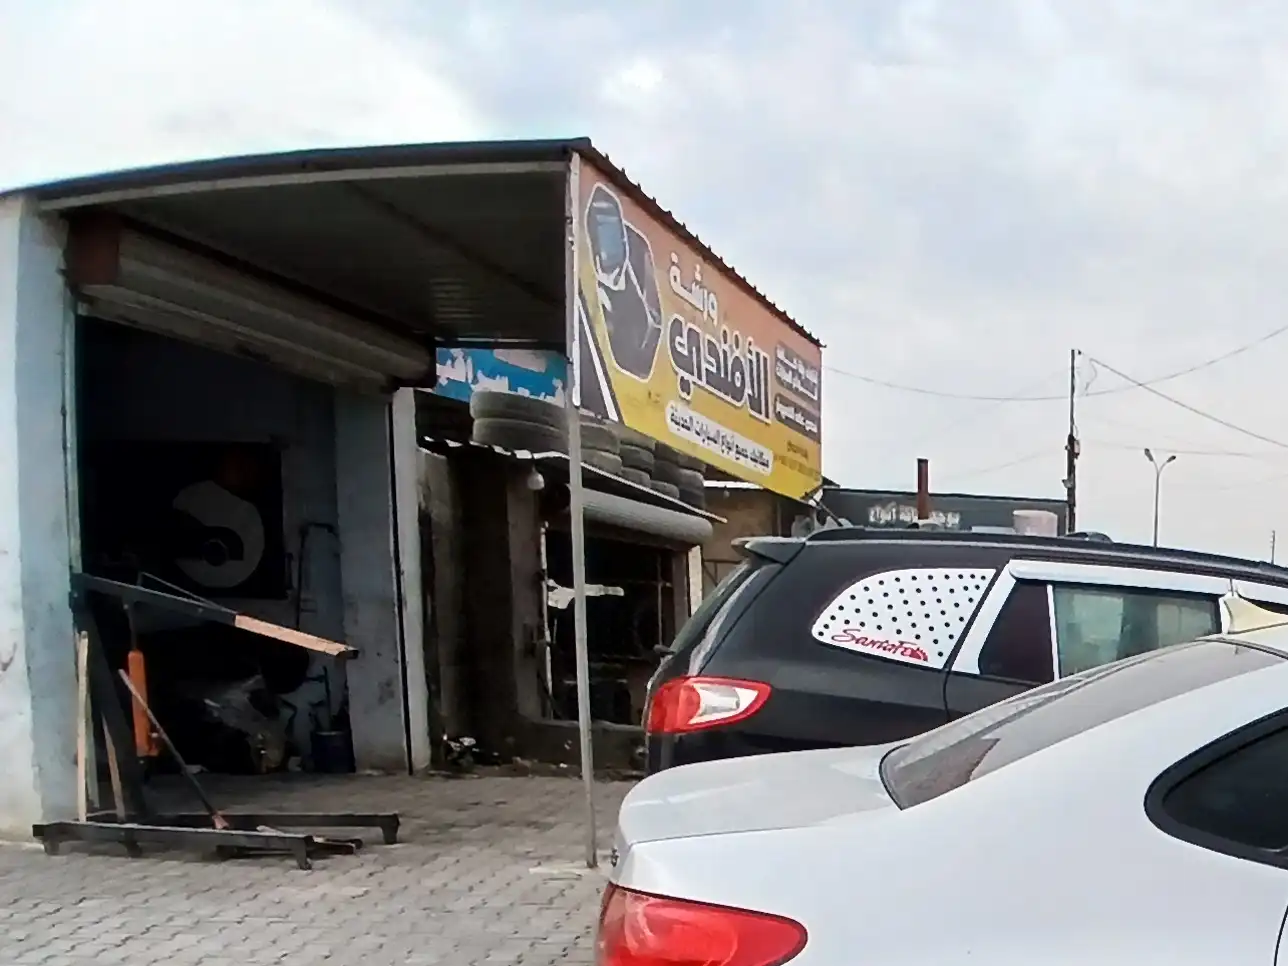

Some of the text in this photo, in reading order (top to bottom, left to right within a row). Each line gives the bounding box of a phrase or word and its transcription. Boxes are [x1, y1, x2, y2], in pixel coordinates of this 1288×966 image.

[669, 251, 718, 324] ورشة
[668, 313, 771, 423] الأفندي
[695, 420, 720, 446] السيارات
[735, 444, 749, 462] جميع
